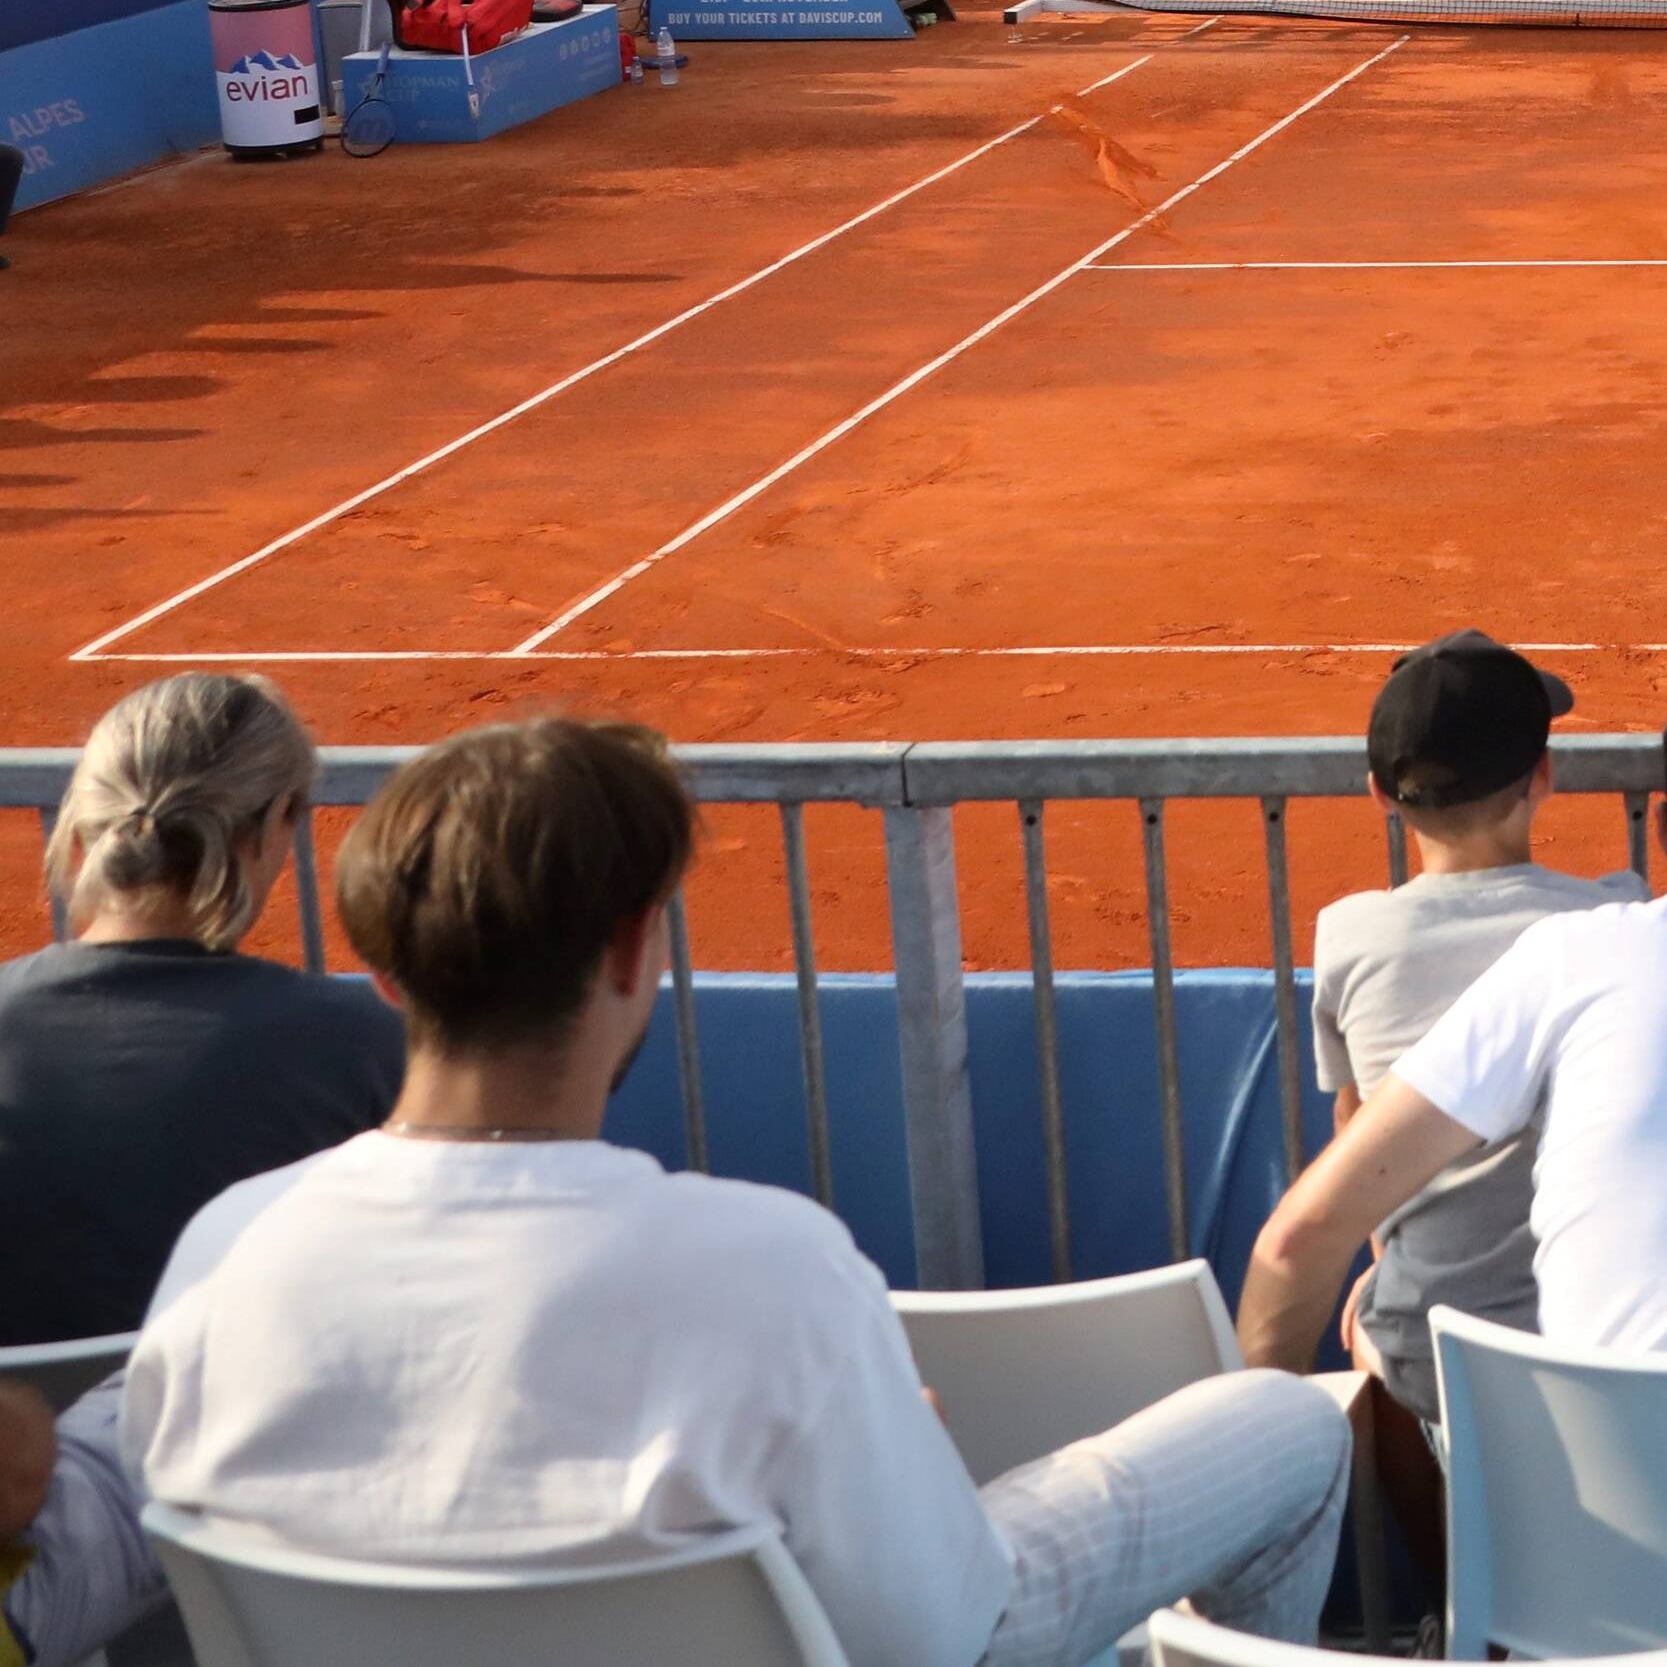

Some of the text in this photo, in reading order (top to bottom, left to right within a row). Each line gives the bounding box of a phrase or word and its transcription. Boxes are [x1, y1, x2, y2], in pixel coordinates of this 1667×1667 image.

[668, 12, 882, 24] BUY YOUR TICKETS AT DAVISCUP.COM
[226, 74, 308, 103] evian
[9, 99, 86, 141] ALPES
